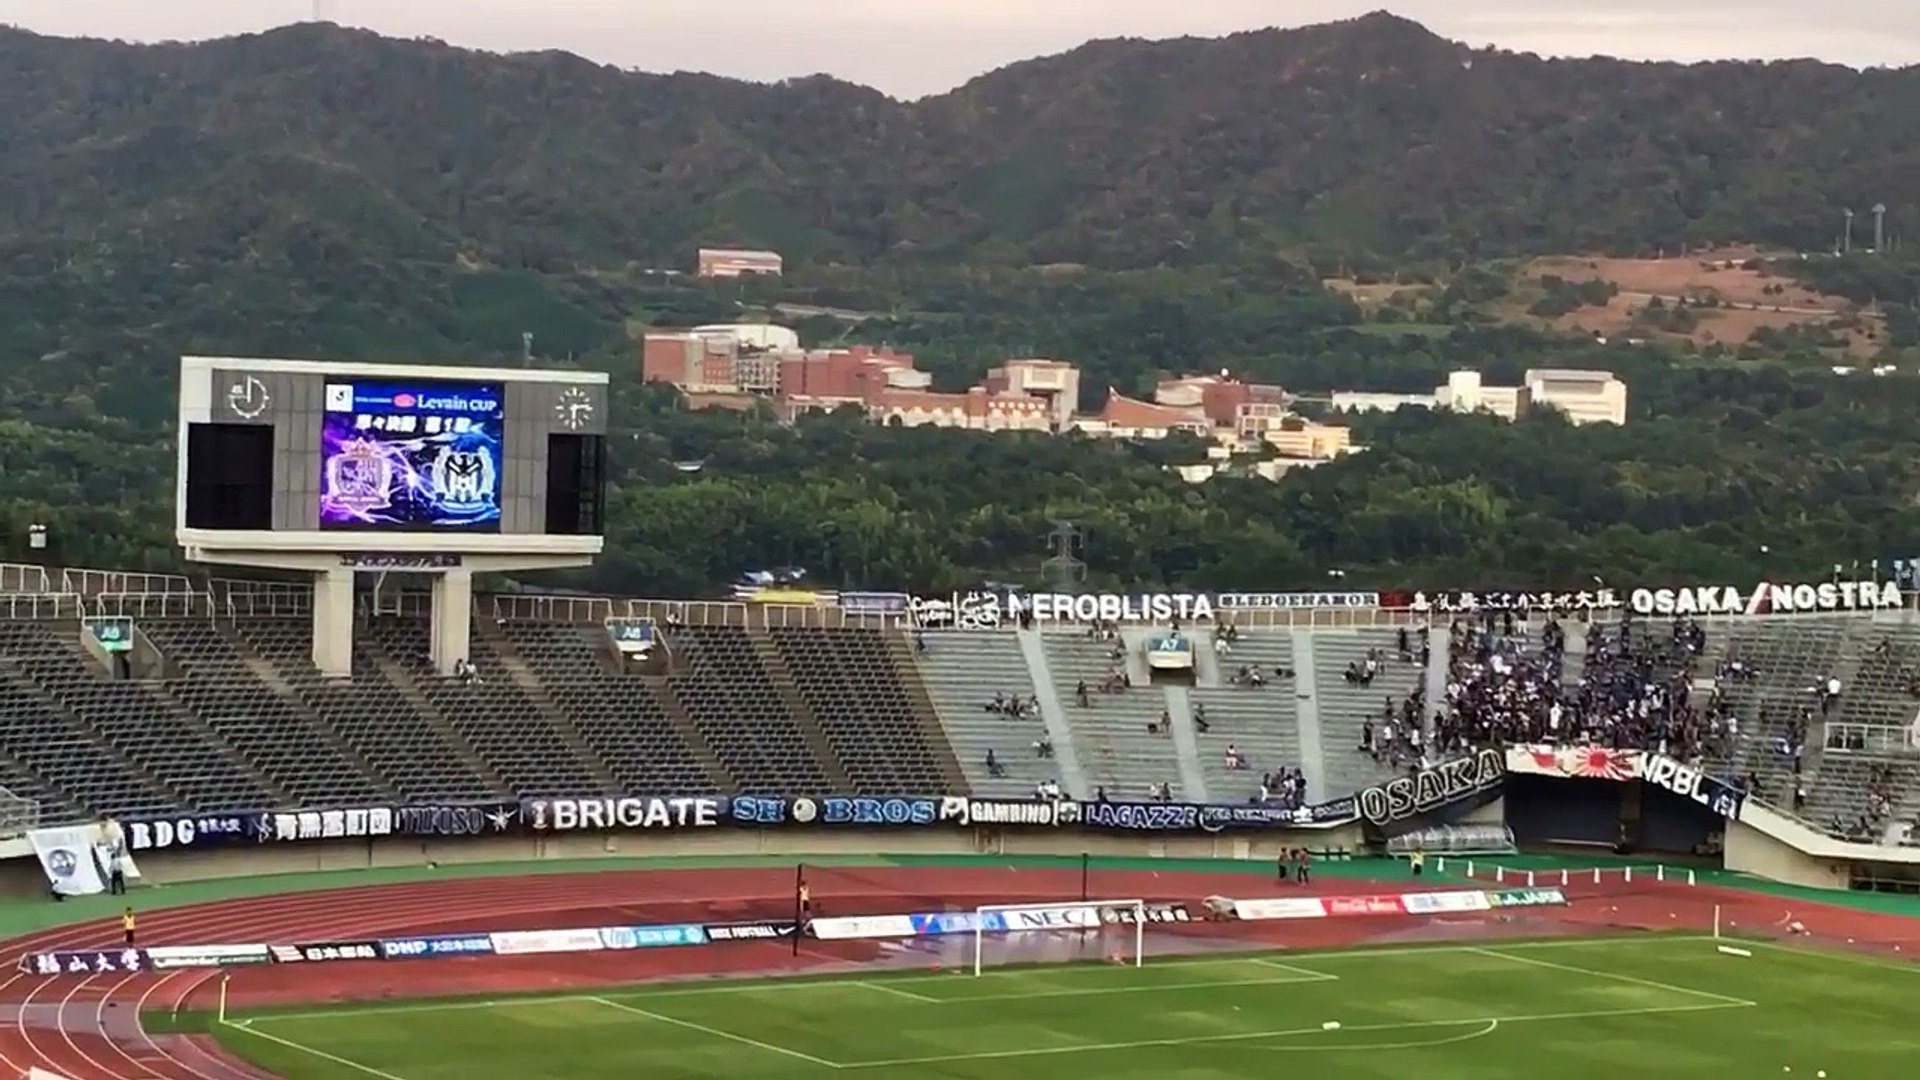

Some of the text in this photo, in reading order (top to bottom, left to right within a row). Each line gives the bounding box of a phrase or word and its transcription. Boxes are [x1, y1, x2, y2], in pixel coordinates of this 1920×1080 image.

[418, 394, 497, 412] Levain CUP
[1361, 747, 1504, 828] OSAKA
[554, 799, 718, 829] BRIGATE
[824, 799, 935, 823] BROS
[131, 819, 195, 849] RDG
[1019, 908, 1083, 927] NEC
[385, 941, 427, 956] DNP
